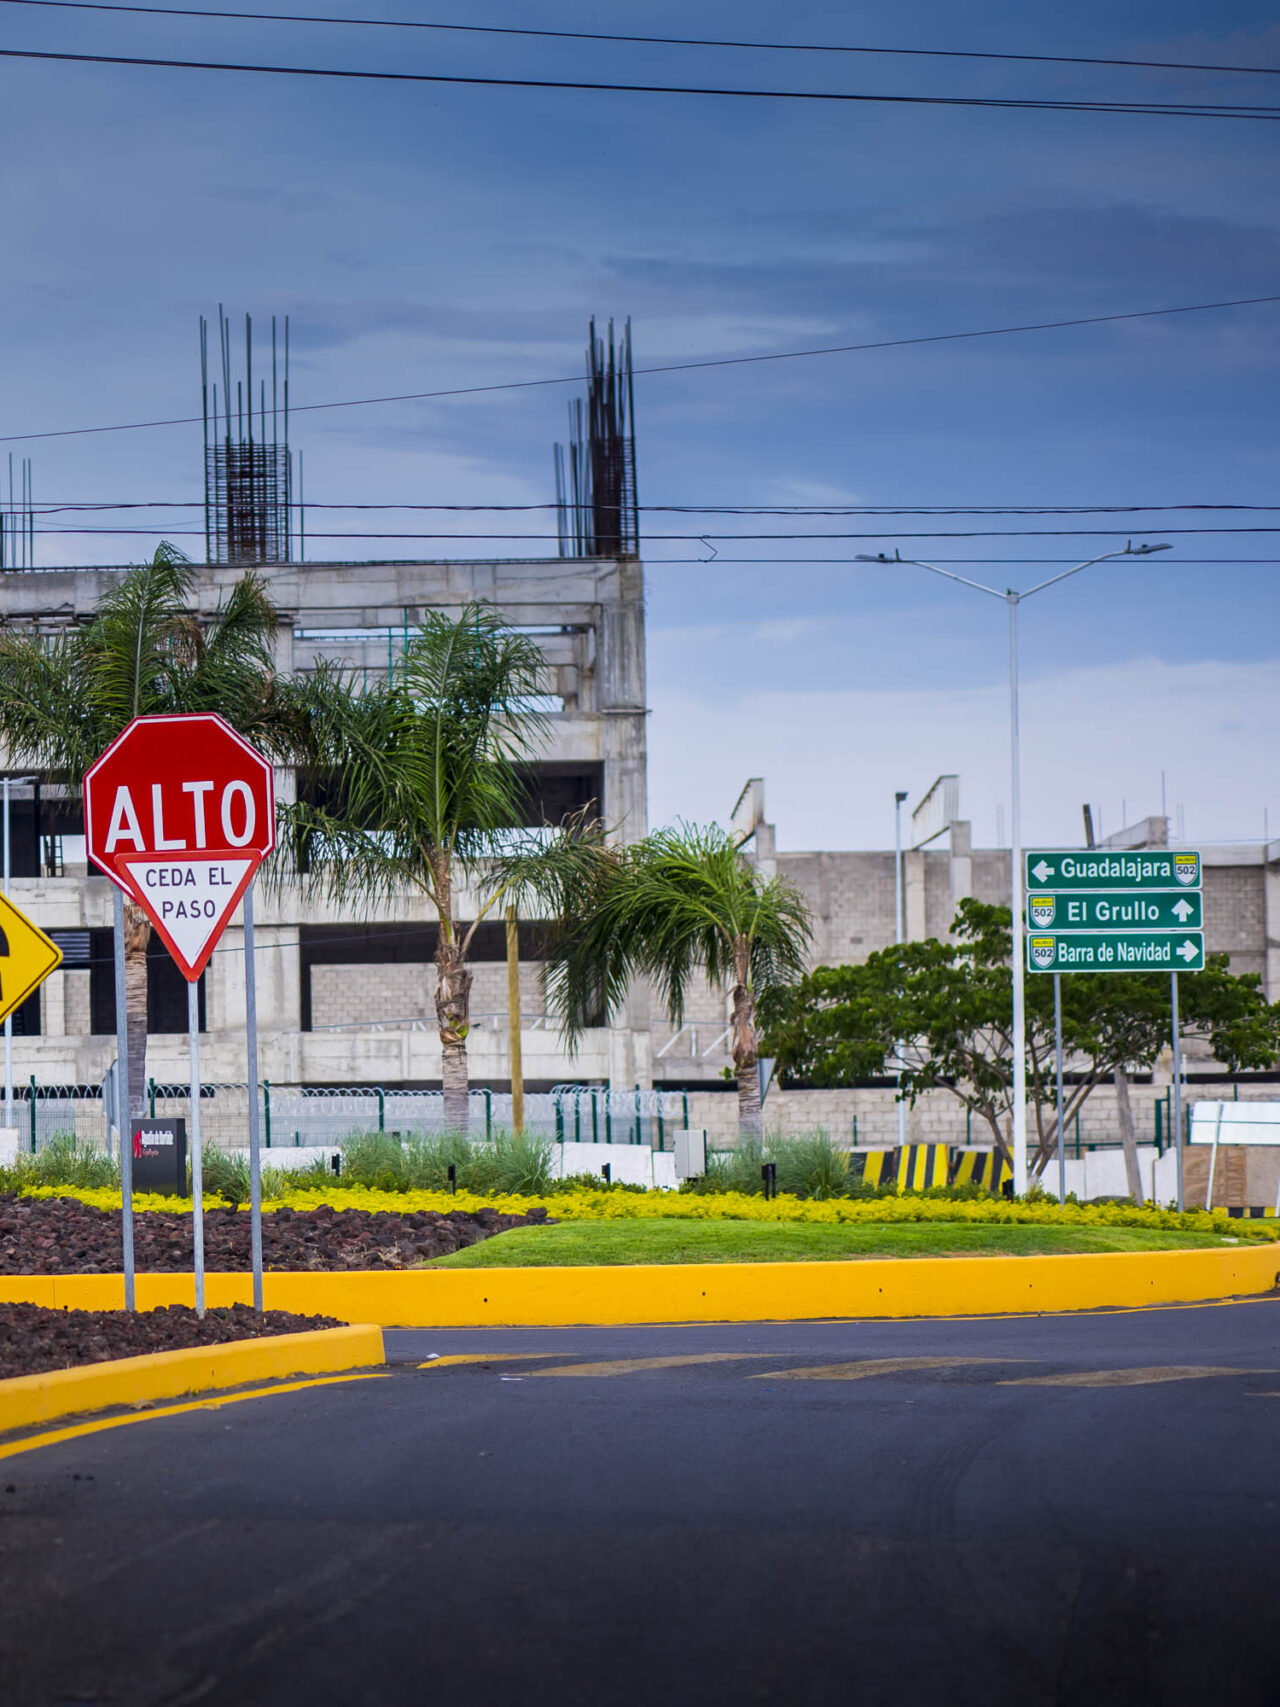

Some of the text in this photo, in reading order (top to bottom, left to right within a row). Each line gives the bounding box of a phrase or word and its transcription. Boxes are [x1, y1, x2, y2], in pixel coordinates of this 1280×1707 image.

[104, 779, 256, 853] ALTO
[145, 866, 232, 887] CEDA EL
[1060, 857, 1171, 882] Guadalajara
[1177, 865, 1197, 875] 502
[162, 899, 216, 919] PASO
[1034, 908, 1052, 917] 502
[1067, 900, 1160, 921] El Grullo
[1034, 949, 1053, 958] 502
[1058, 941, 1171, 962] Barra de Navidad
